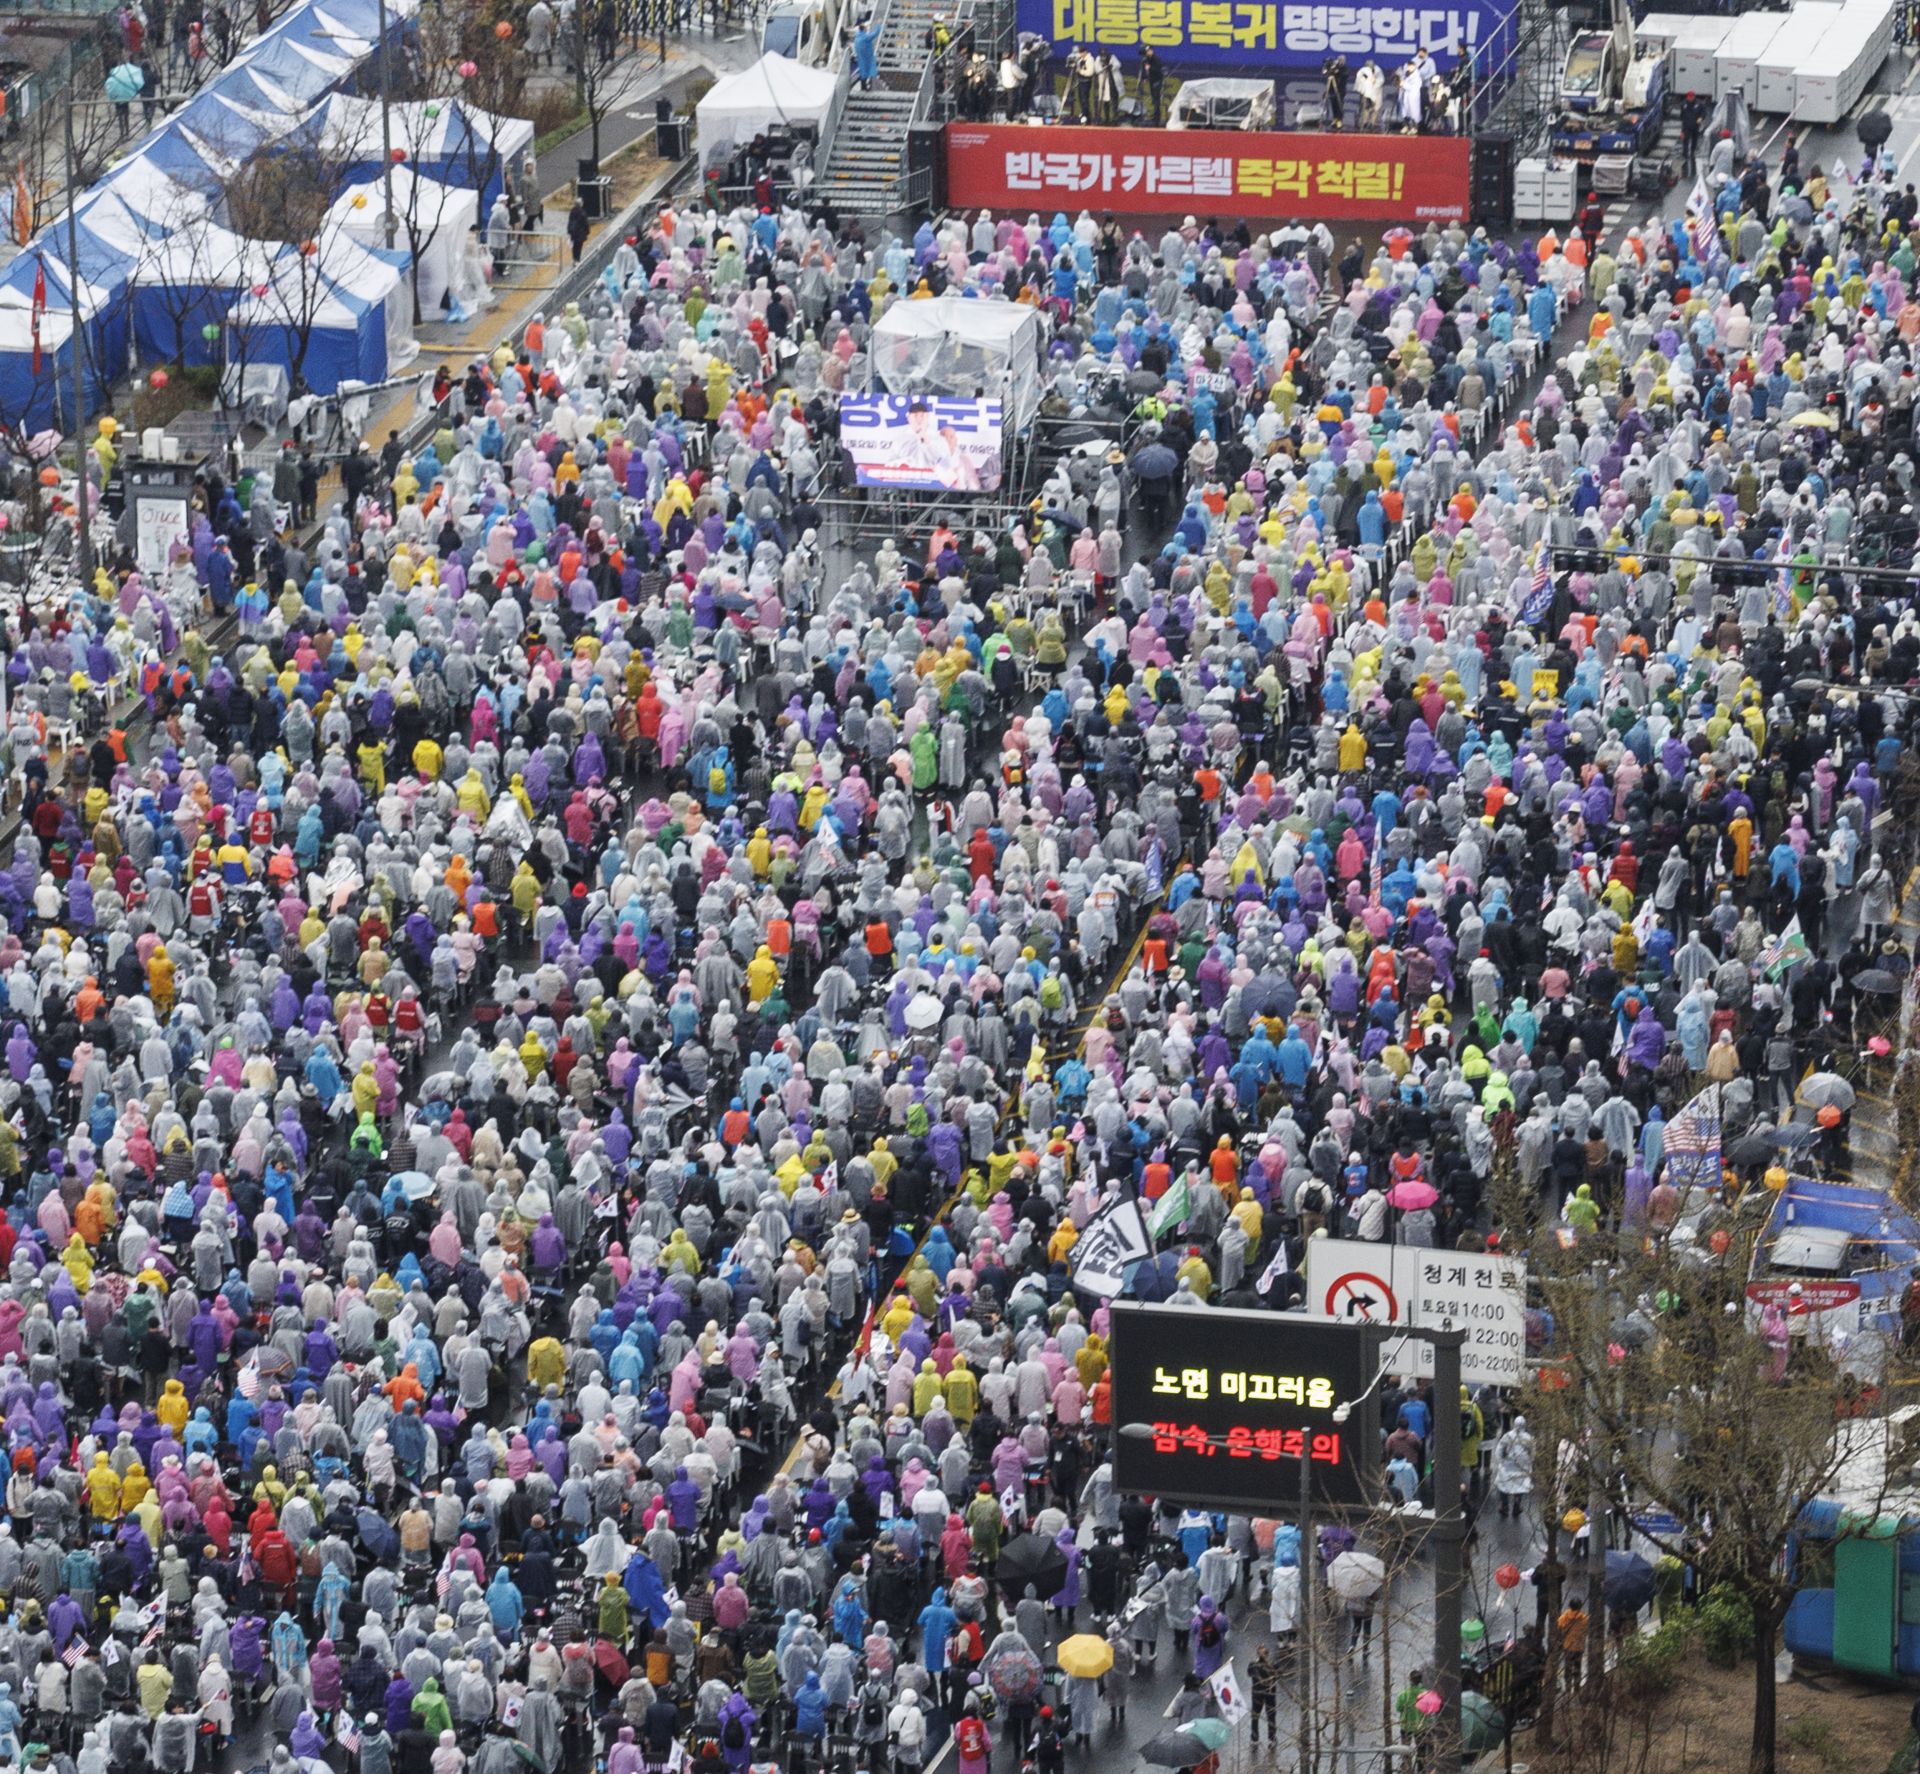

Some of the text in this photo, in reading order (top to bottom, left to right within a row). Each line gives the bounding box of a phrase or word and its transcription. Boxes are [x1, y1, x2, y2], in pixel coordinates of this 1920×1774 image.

[1053, 0, 1480, 56] 대통령 복귀 명령한다!
[1005, 152, 1405, 200] 반국가 카르텔 즉각 척결!
[1424, 1264, 1518, 1289] 청계천로
[1422, 1299, 1505, 1321] 토요일 14:00
[1476, 1328, 1519, 1348] 22:00
[1152, 1366, 1335, 1409] 노면 미끄러움
[1151, 1421, 1217, 1457] 감속,
